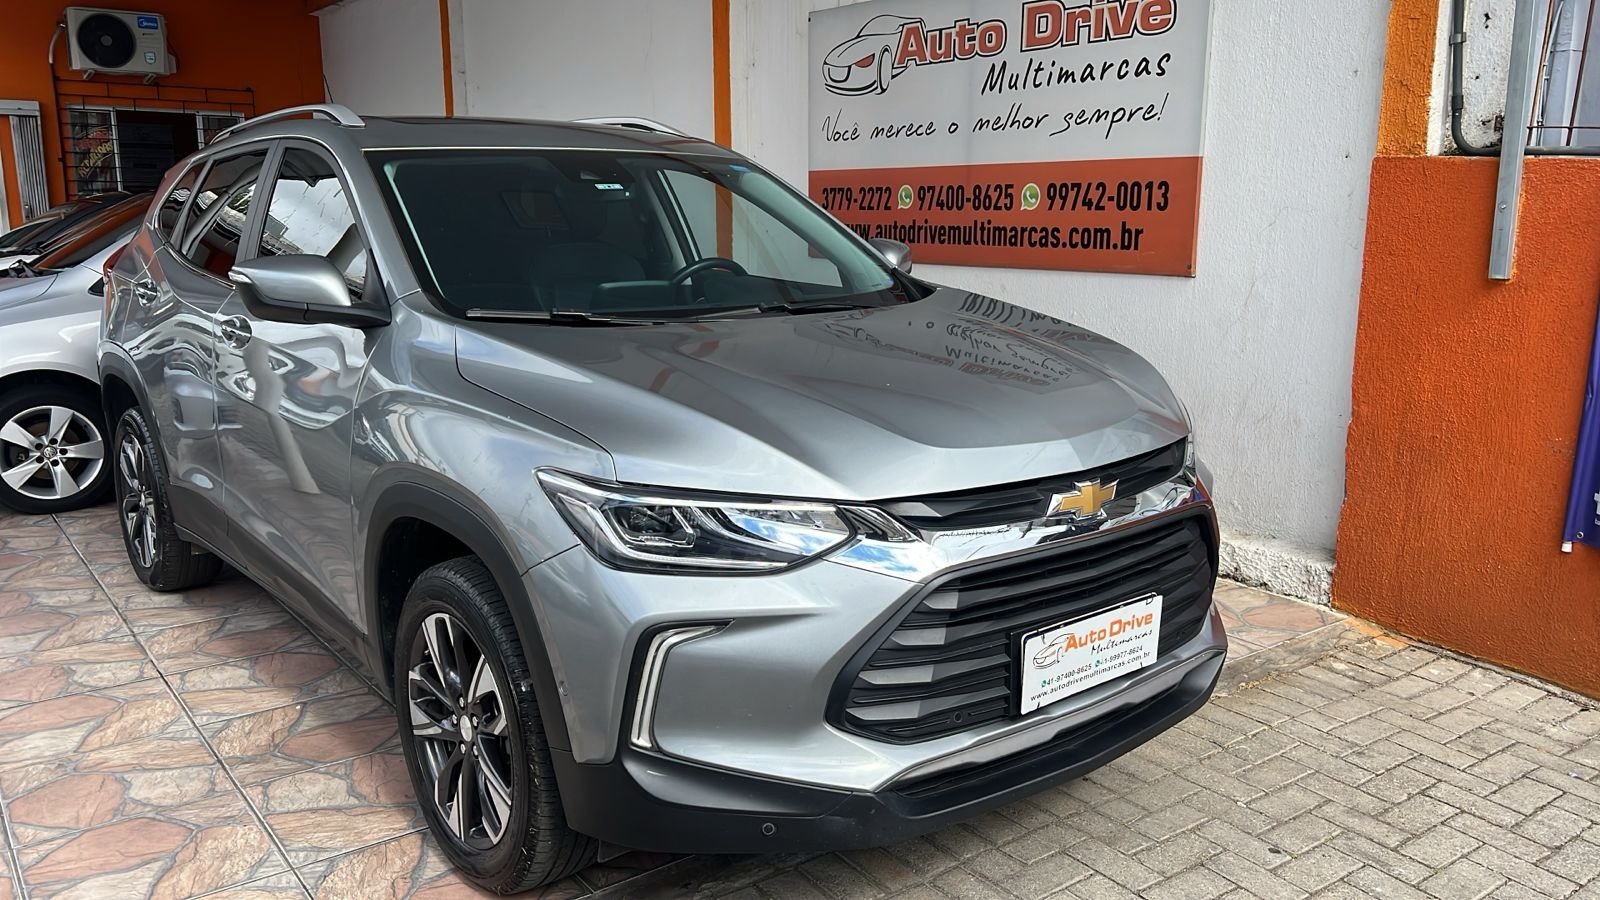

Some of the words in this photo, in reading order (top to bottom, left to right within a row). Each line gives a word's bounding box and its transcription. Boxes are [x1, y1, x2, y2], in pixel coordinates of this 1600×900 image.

[893, 18, 1007, 68] Auto
[1020, 0, 1177, 52] Drive
[981, 53, 1171, 95] Multimarcas
[822, 108, 860, 142] Você
[870, 121, 937, 140] merece
[948, 122, 959, 134] o
[973, 103, 1049, 133] melhor
[1049, 92, 1169, 140] sempre!
[822, 186, 892, 211] 3779-2272
[917, 184, 1014, 212] 97400-8625
[1046, 180, 1170, 212] 99742-0013
[1064, 629, 1107, 653] Auto
[1109, 613, 1153, 638] Drive
[1091, 629, 1152, 656] Multimarcas
[1030, 651, 1150, 702] www.autodrivemultimarcas.com.br
